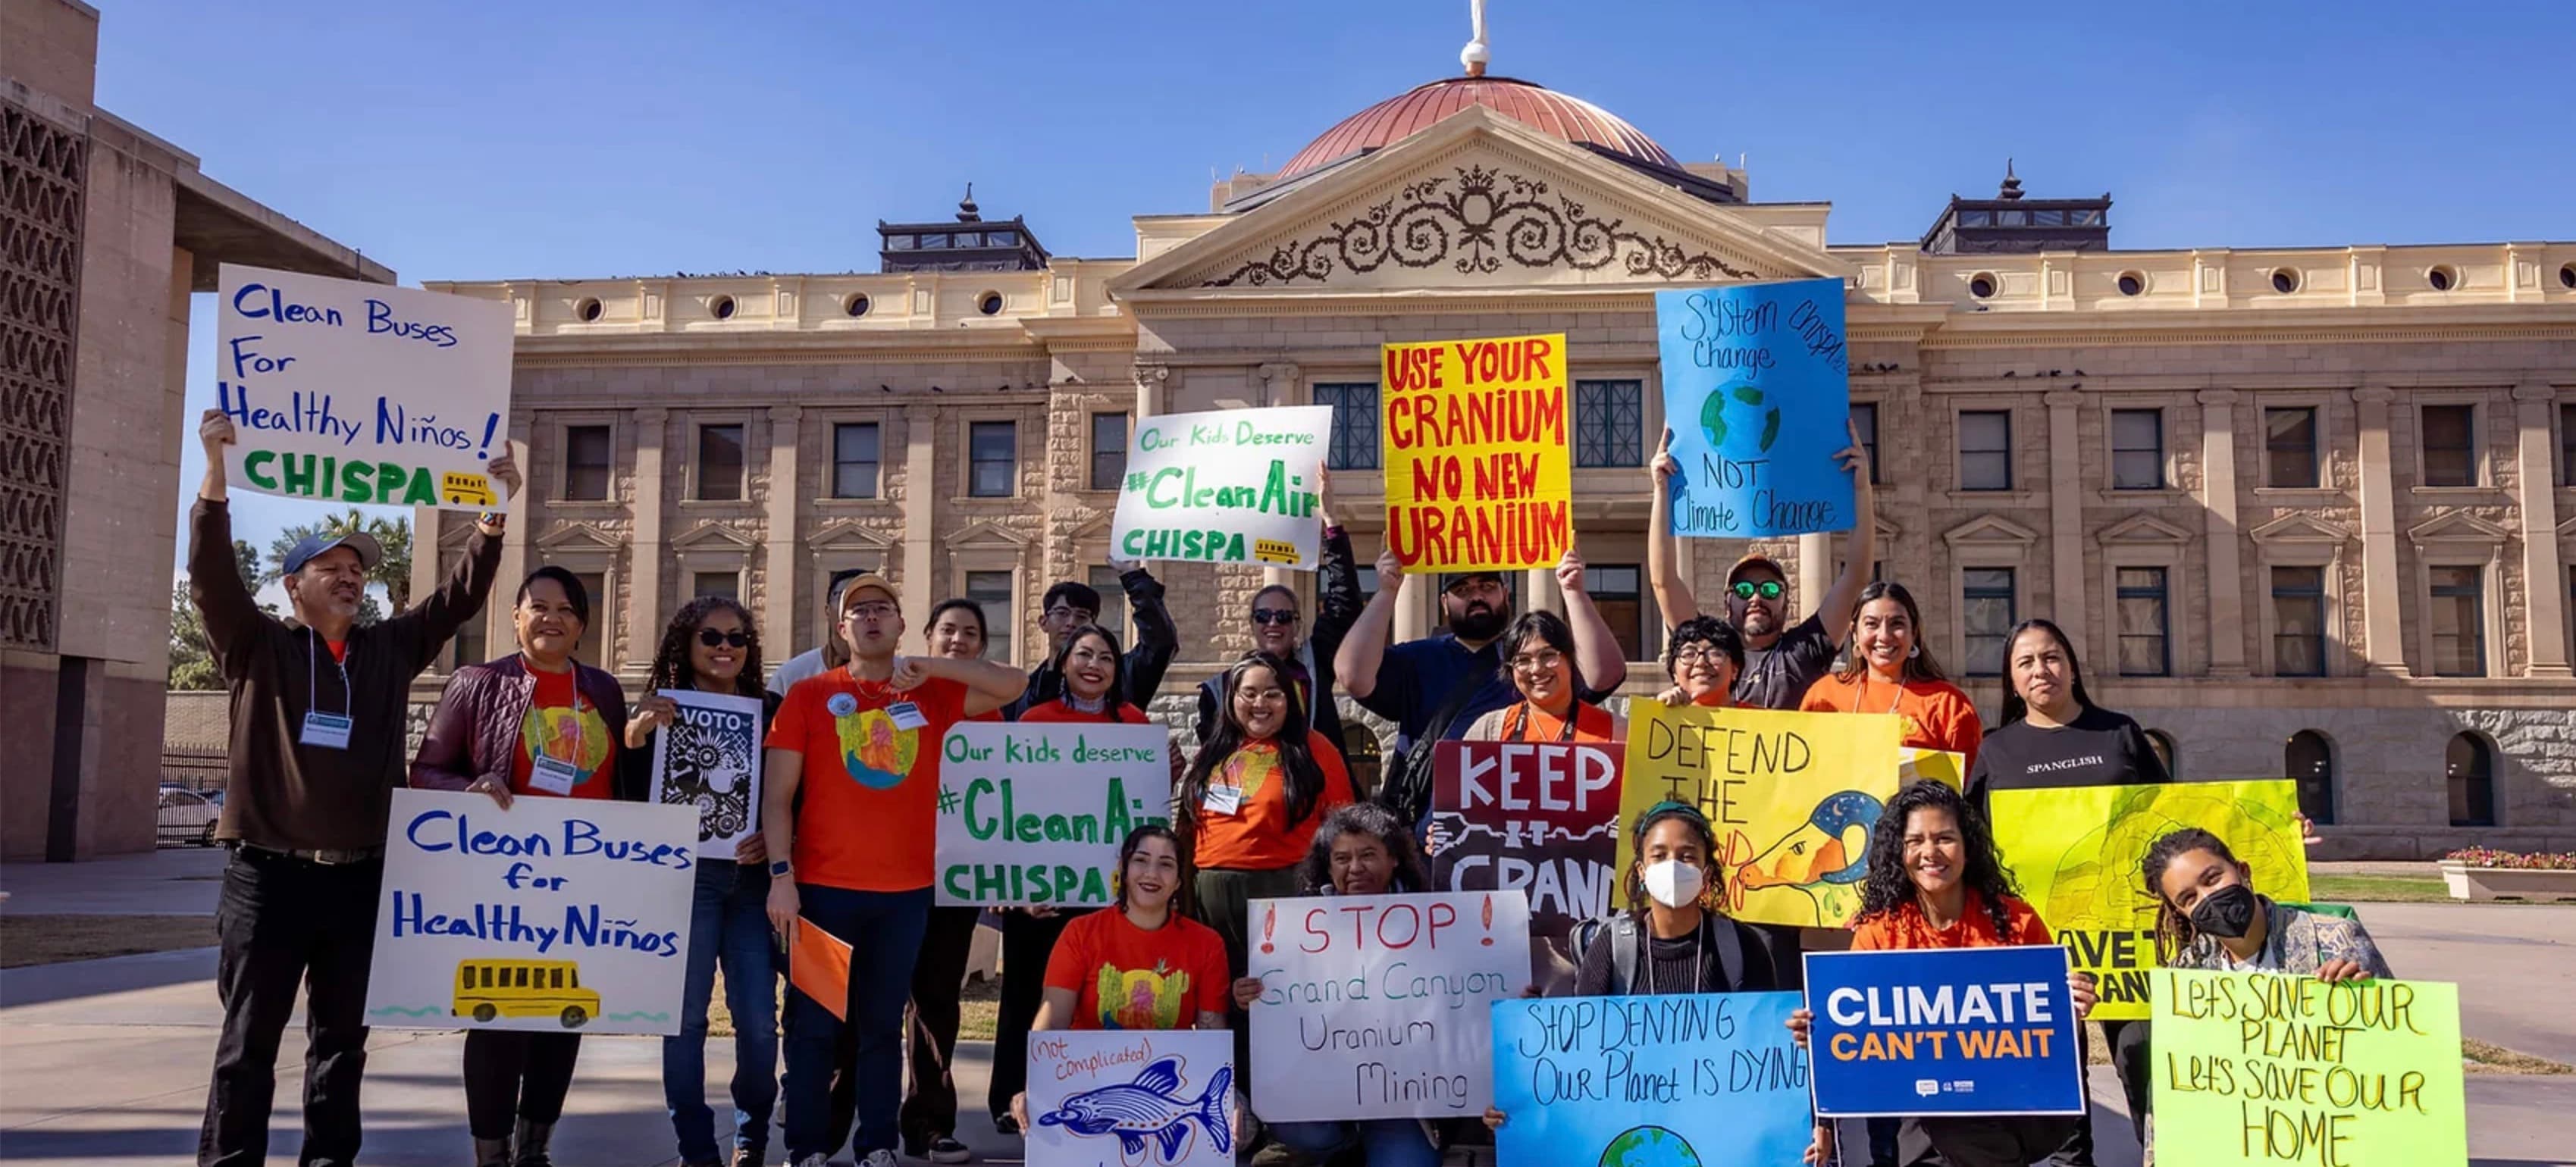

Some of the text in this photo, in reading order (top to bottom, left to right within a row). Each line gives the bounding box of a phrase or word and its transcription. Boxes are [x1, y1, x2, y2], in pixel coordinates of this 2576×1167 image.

[233, 283, 457, 347] Clean Buses
[230, 336, 296, 378] For
[1387, 339, 1553, 393] USE YOUR
[1694, 341, 1776, 380] Change
[218, 382, 362, 446] Healthy
[1140, 421, 1315, 452] Our Kids Deserve
[244, 450, 437, 505] CHISPA
[1412, 452, 1540, 502] NO NEW
[1703, 453, 1769, 489] NOT
[1672, 486, 1837, 531] Climate Change
[1123, 529, 1245, 562] CHISPA
[683, 709, 741, 731] VOTO
[945, 734, 1155, 763] Our kids deserve
[1648, 717, 1811, 775] DEFEND
[2026, 756, 2104, 774] SPANGLISH
[1460, 744, 1615, 812] KEEP
[1661, 775, 1748, 824] THE
[407, 810, 692, 869] Clean Buses
[1505, 820, 1549, 848] IT
[502, 862, 569, 891] for
[944, 865, 1108, 903] CHISPA
[393, 891, 679, 958] Healthy Niños
[1299, 903, 1456, 954] STOP
[2057, 930, 2137, 968] AVE
[1259, 962, 1507, 1009] Grand Canyon
[1827, 982, 2052, 1027] CLIMATE
[1299, 1014, 1434, 1051] Uranium
[1600, 998, 1735, 1050] DENYING
[1830, 1028, 2054, 1062] CAN'T WAIT
[2241, 1021, 2367, 1063] PLANET
[1030, 1037, 1068, 1063] (not
[1056, 1037, 1152, 1081] complicated)
[1601, 1048, 1680, 1103] Planet
[1693, 1059, 1719, 1097] IS
[1728, 1041, 1807, 1093] DYING
[1356, 1062, 1468, 1109] Mining
[2242, 1100, 2358, 1167] HOME
